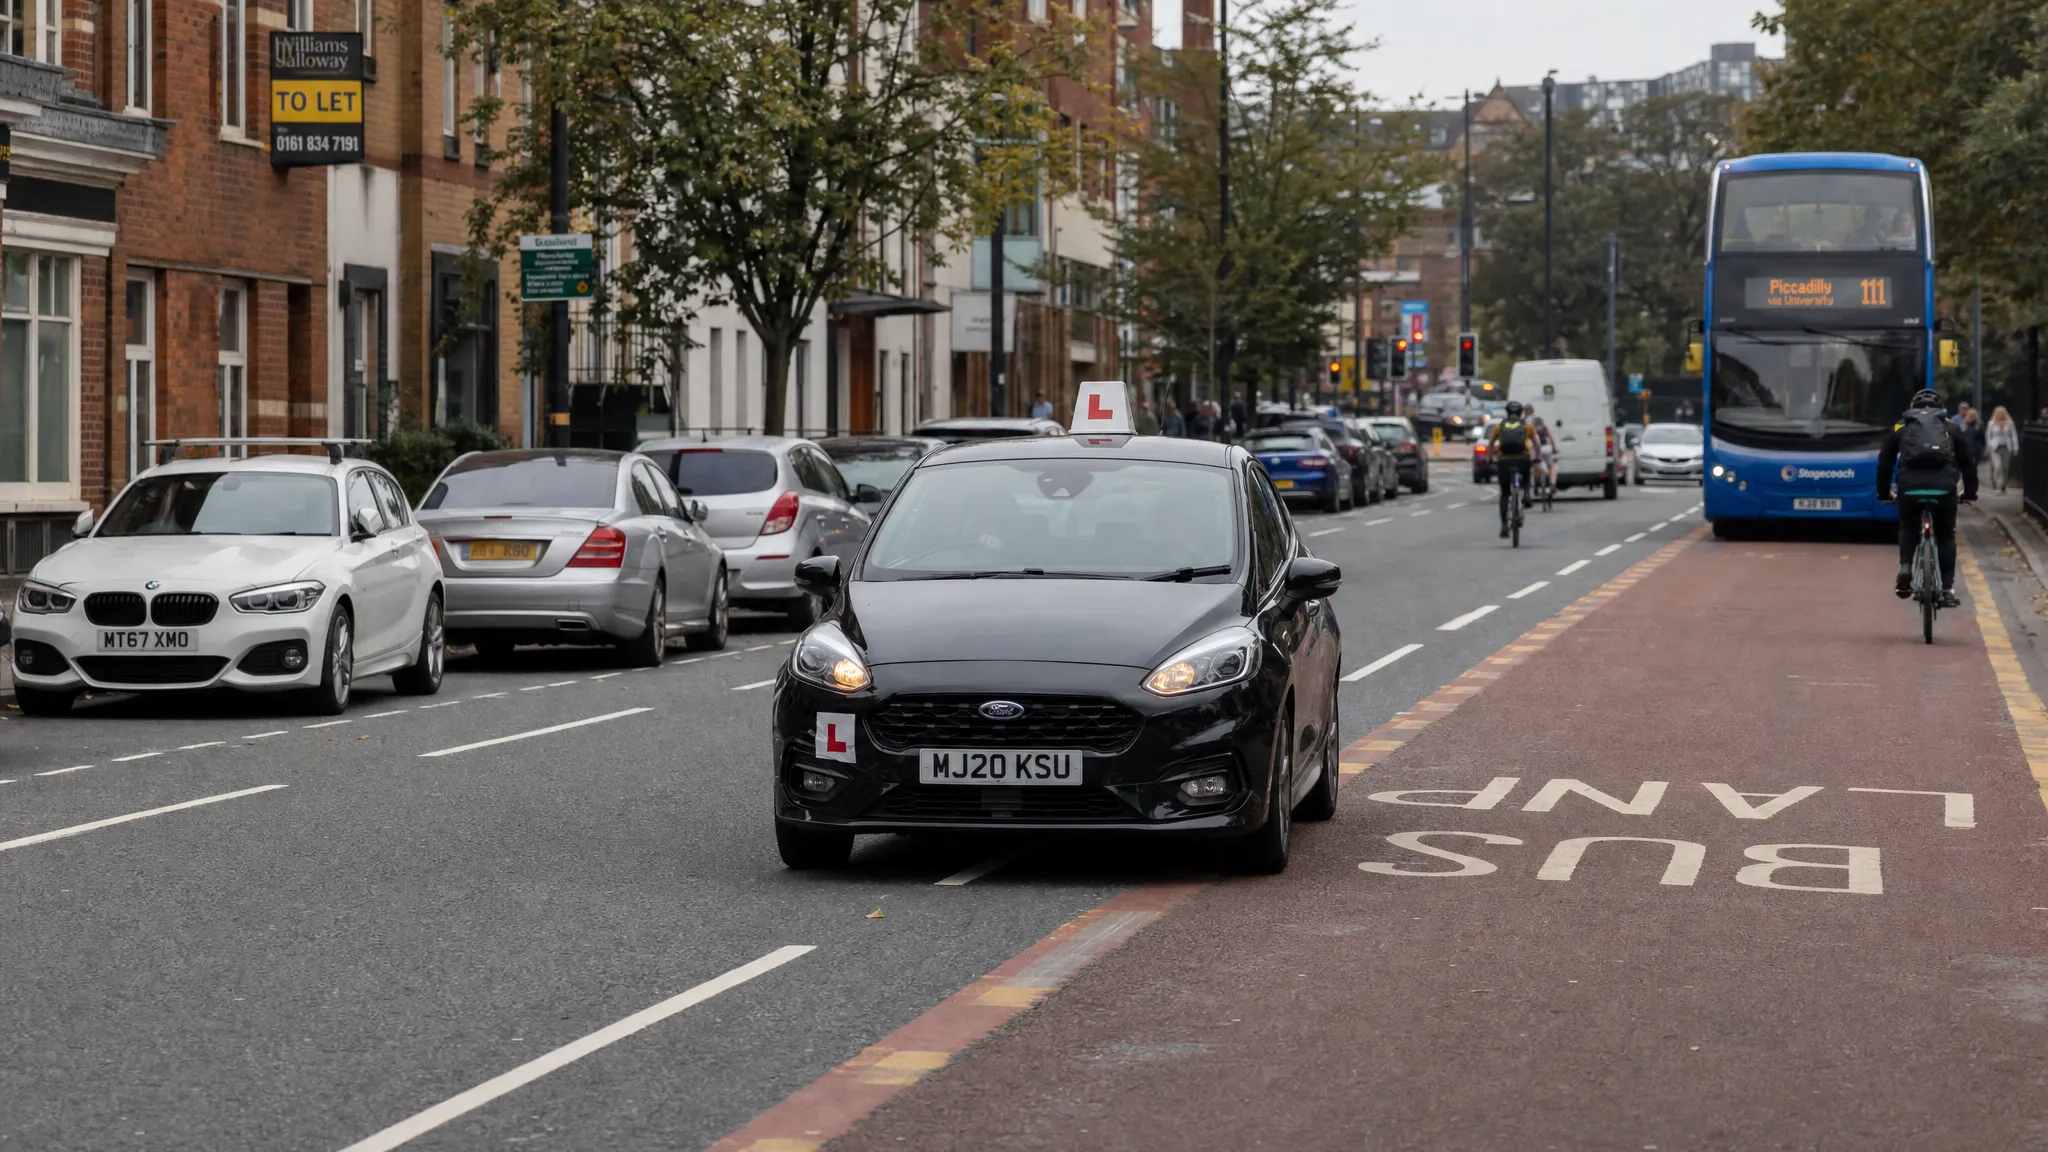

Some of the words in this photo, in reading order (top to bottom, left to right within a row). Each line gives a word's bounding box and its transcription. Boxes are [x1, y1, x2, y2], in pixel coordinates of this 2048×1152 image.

[276, 91, 307, 112] TO
[316, 91, 357, 112] LET
[276, 135, 303, 152] 0161
[306, 135, 330, 152] 834
[332, 135, 359, 152] 7191
[1769, 278, 1832, 295] Piccadilly
[1860, 278, 1886, 305] 111
[1088, 394, 1113, 420] L
[1798, 468, 1855, 480] Stagecoach
[104, 631, 149, 648] MT67
[154, 631, 188, 648] XMO
[827, 723, 847, 753] L
[933, 753, 1006, 779] MJ20
[1015, 753, 1070, 780] KSU
[1358, 831, 1884, 894] BUS
